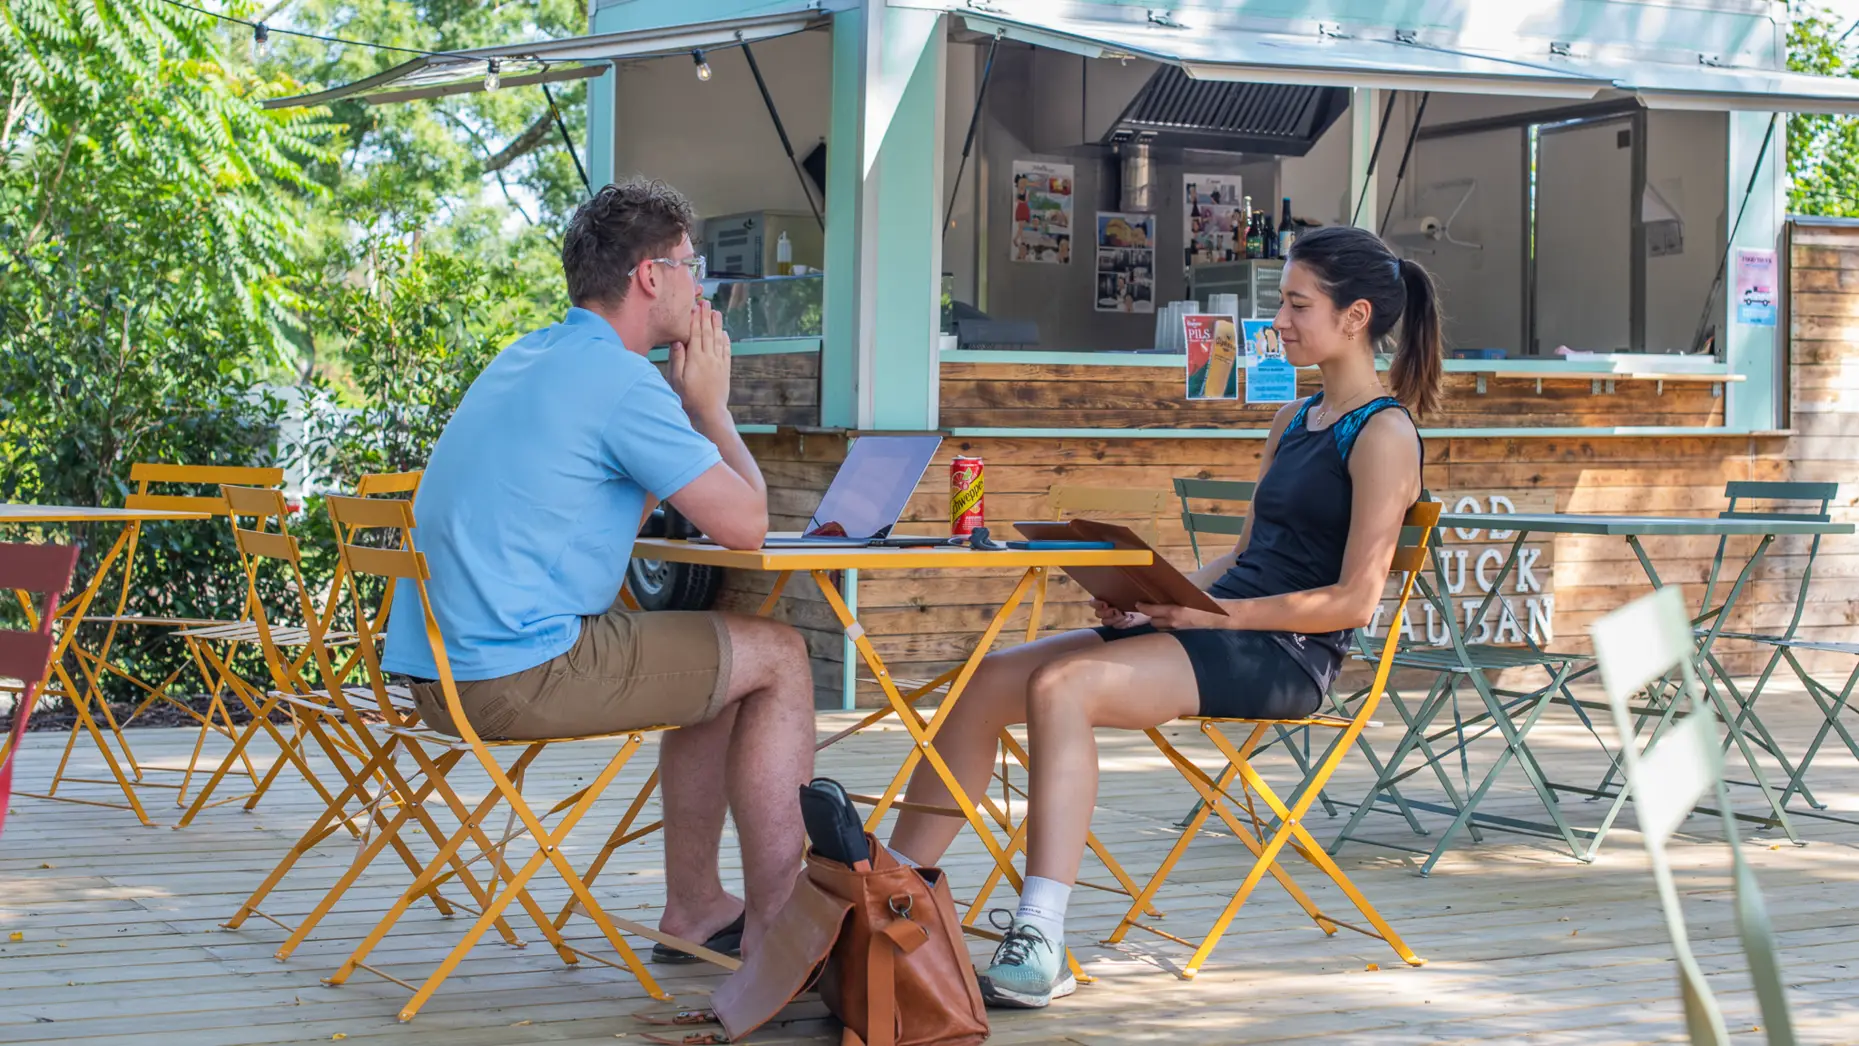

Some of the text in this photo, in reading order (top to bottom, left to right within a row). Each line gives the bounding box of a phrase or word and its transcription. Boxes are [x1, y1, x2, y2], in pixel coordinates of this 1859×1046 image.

[1188, 328, 1211, 339] PILS
[1430, 496, 1516, 540] OD
[1399, 549, 1541, 596] UCK
